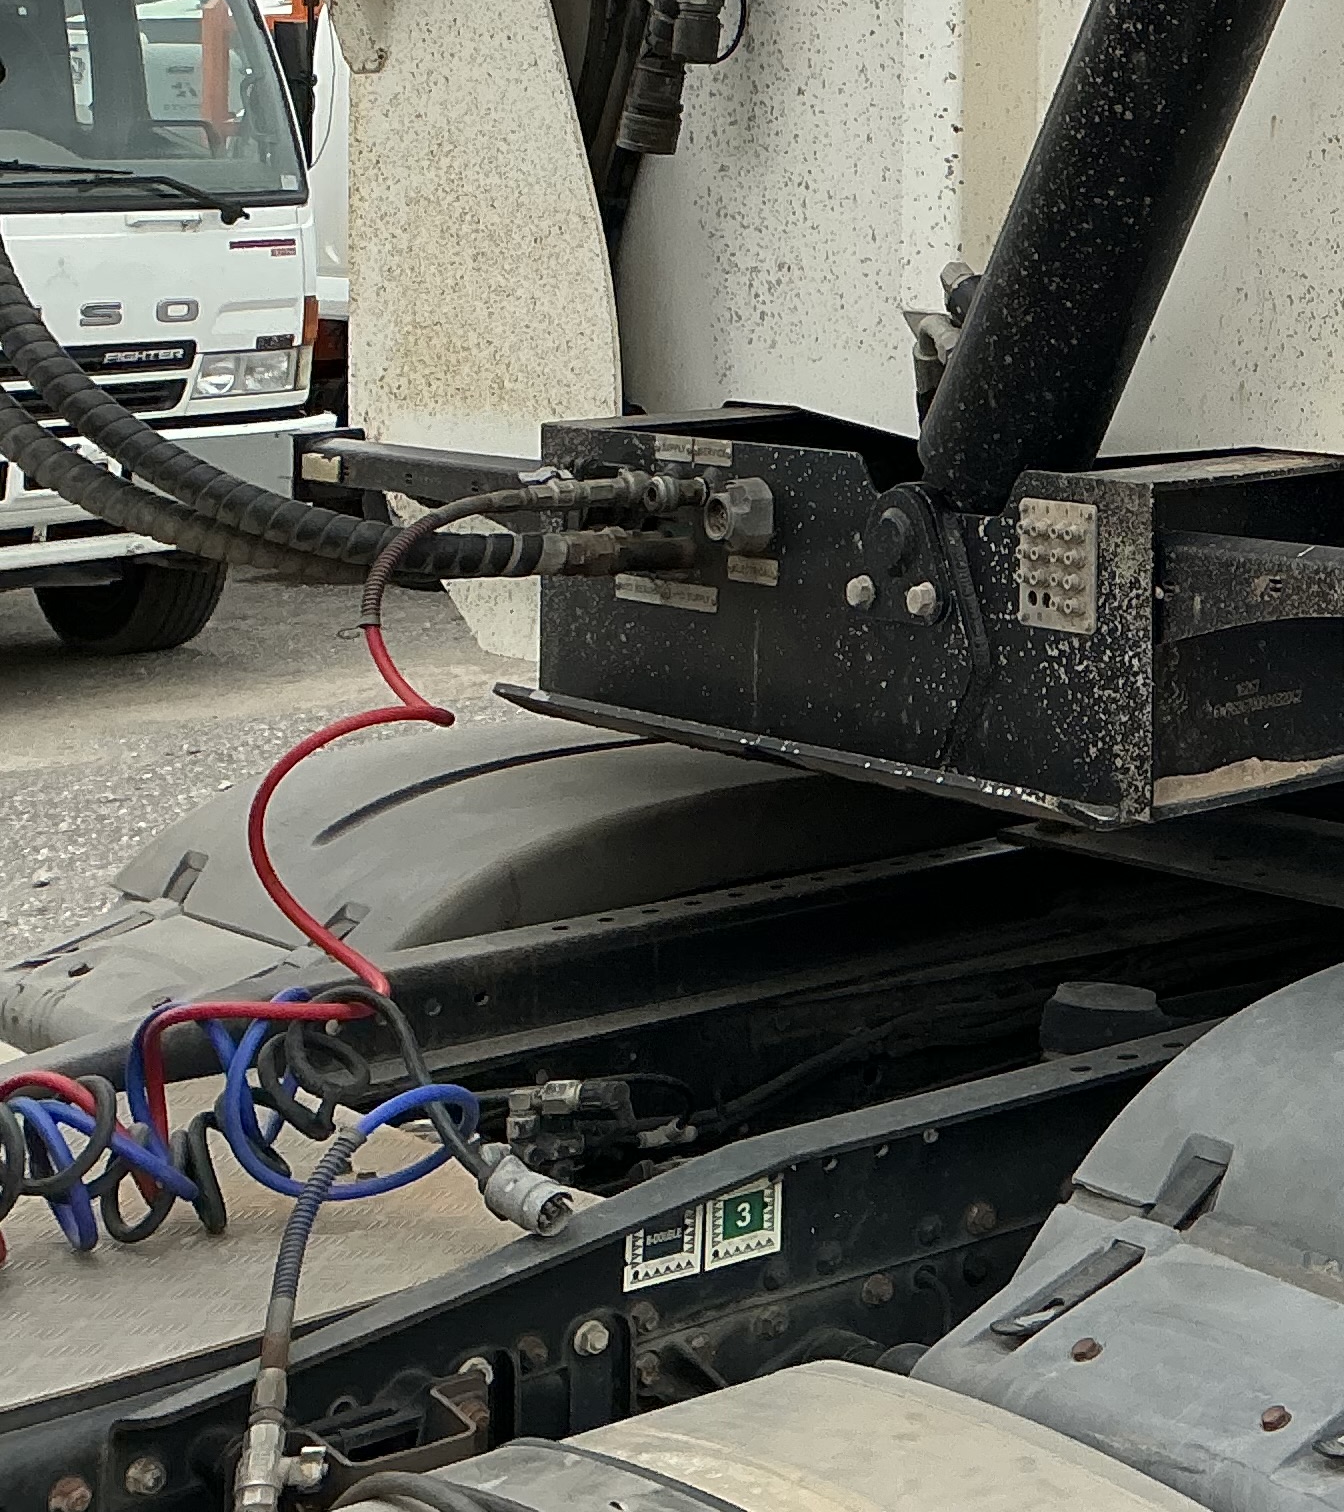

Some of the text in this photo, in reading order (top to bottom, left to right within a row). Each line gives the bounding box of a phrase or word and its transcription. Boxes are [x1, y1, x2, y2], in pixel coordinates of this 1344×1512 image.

[79, 298, 200, 327] SO
[103, 347, 185, 364] FIGHTER
[735, 1201, 751, 1228] 3
